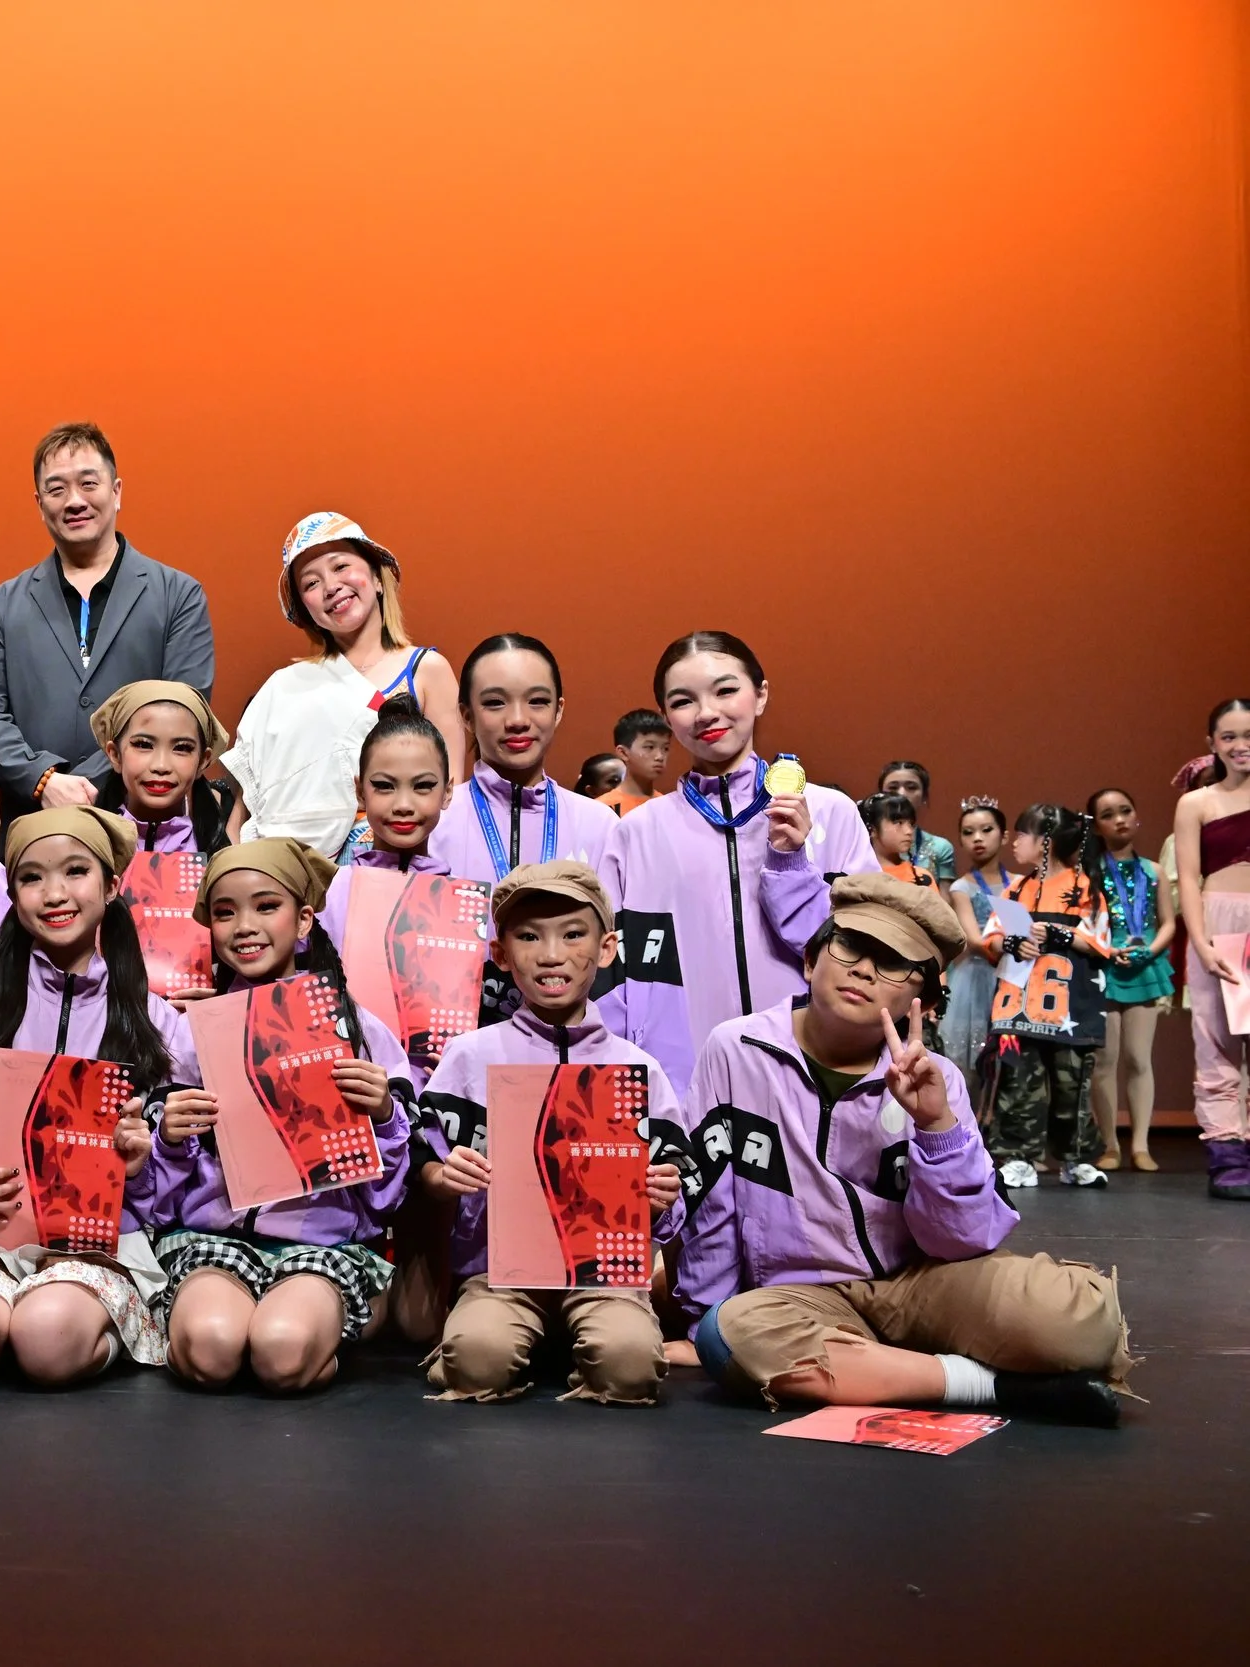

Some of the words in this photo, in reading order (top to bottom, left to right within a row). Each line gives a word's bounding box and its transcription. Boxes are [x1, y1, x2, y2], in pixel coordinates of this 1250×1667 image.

[1015, 1020, 1058, 1036] SPIRIT
[56, 1133, 114, 1149] 香港舞林盛
